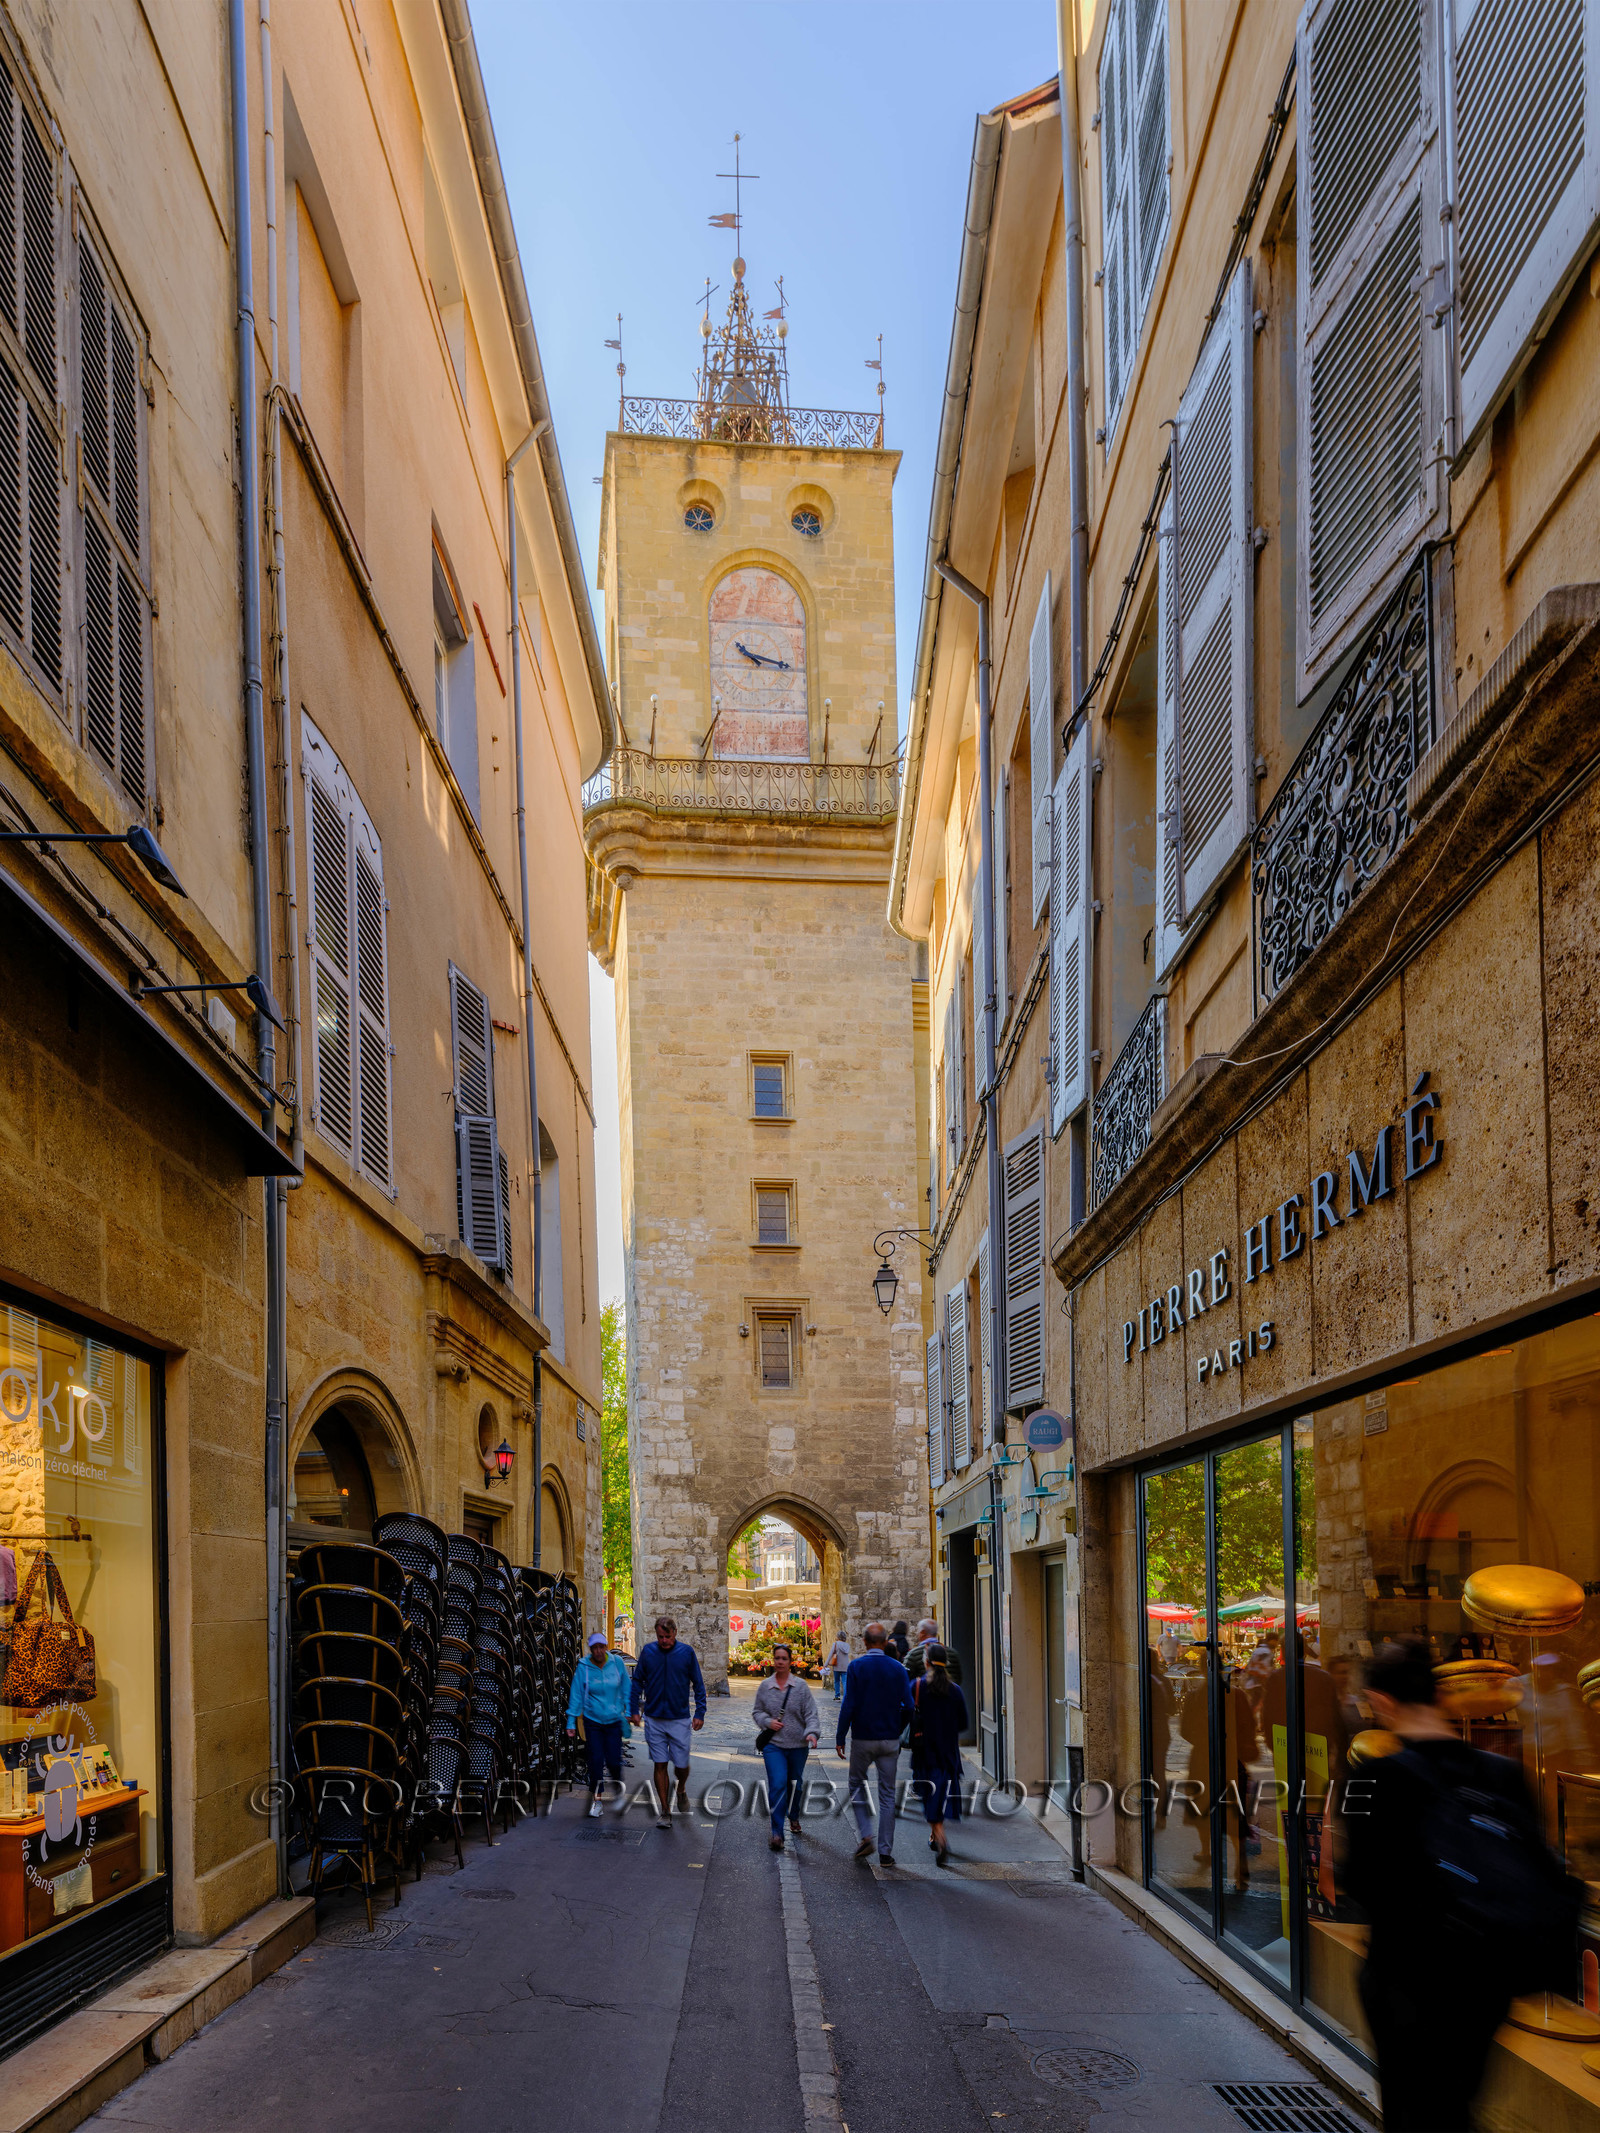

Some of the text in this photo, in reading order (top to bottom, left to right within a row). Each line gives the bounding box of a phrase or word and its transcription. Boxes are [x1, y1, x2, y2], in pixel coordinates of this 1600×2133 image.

[1122, 1071, 1444, 1363] PIERRE HERMÉ
[1197, 1321, 1276, 1382] PARIS
[45, 1457, 69, 1474] zéro
[72, 1461, 108, 1481] déchet
[19, 1724, 36, 1762] vous
[34, 1702, 57, 1724] avez
[60, 1697, 69, 1711] le
[70, 1702, 97, 1744] pouvoir
[1276, 1737, 1287, 1747] PIE
[21, 1815, 97, 1895] de changer le monde
